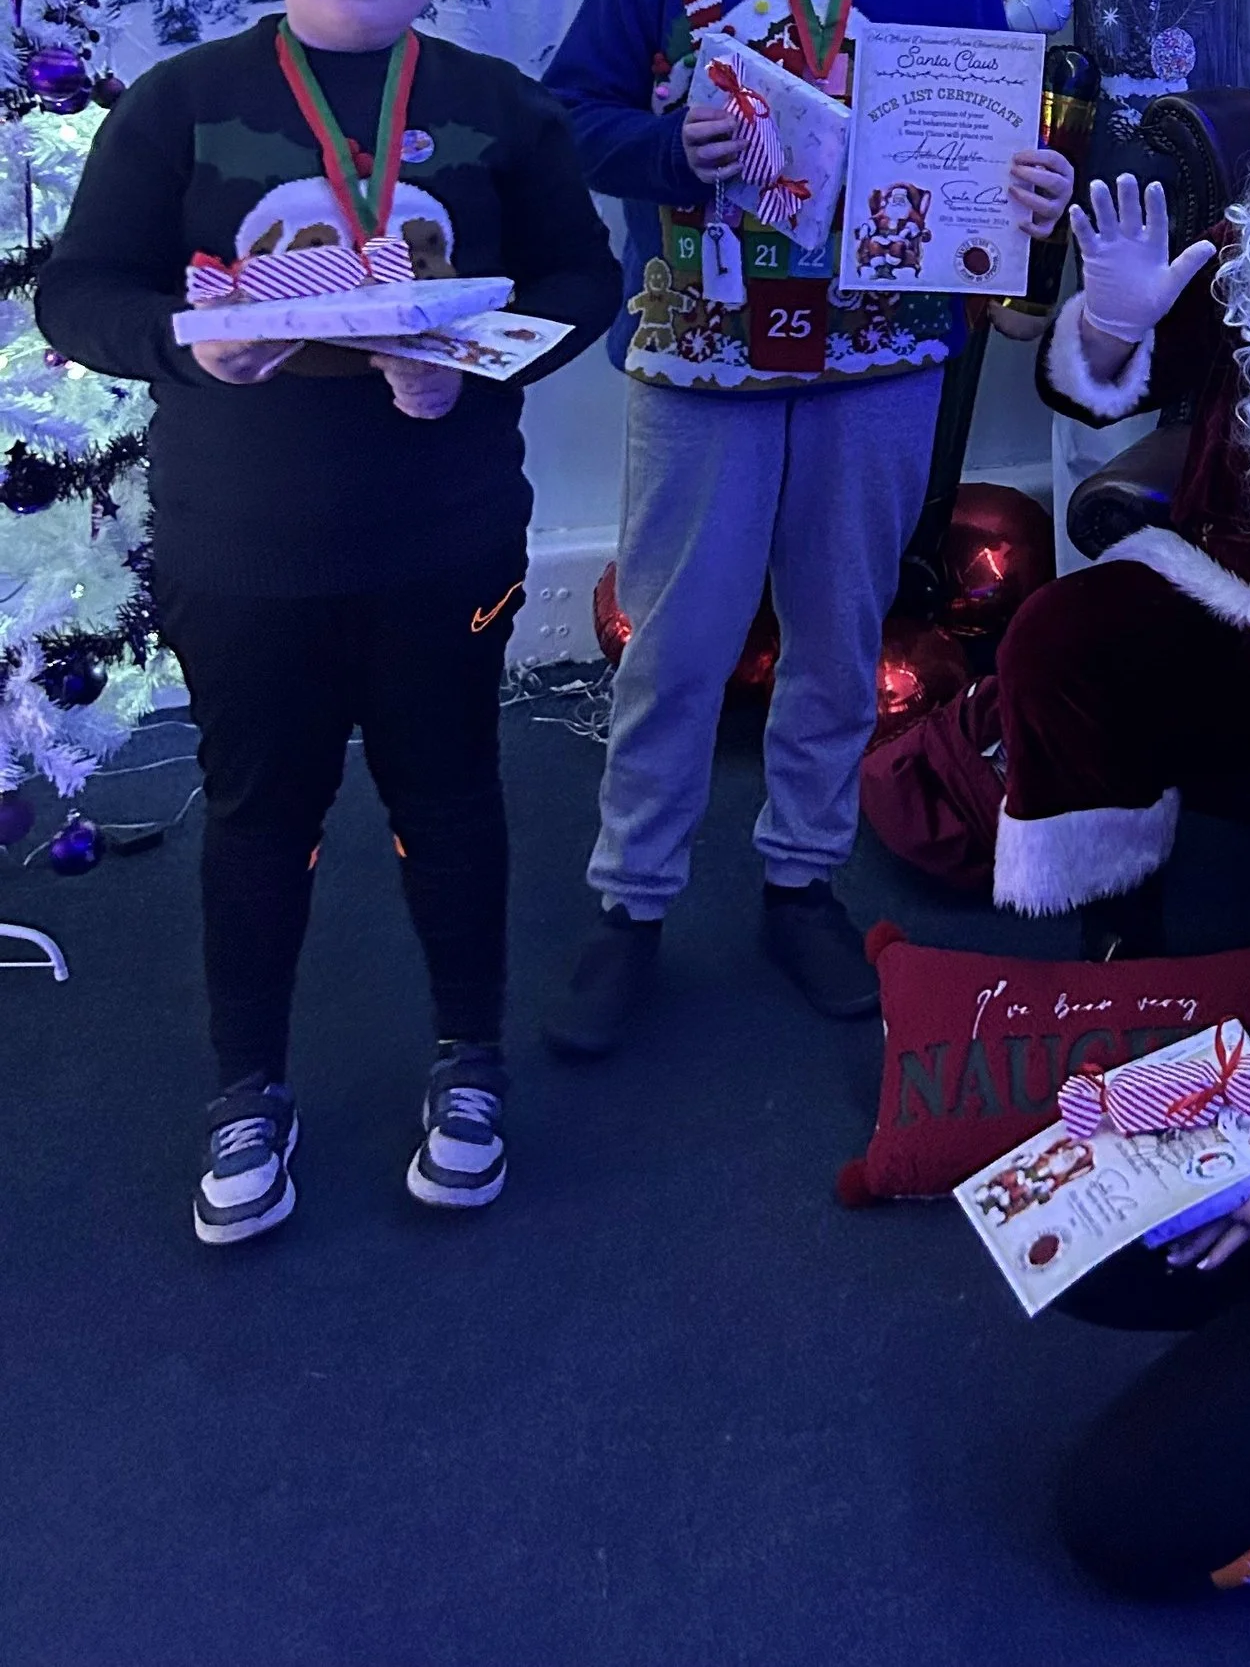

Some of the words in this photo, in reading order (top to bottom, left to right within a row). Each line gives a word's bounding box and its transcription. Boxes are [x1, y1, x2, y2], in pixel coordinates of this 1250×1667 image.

[897, 45, 951, 69] Santa
[954, 50, 999, 72] Claus
[868, 97, 900, 123] NICE
[902, 88, 934, 106] LIST
[937, 87, 1024, 129] CERTIFICATE
[918, 110, 959, 119] recognition
[959, 110, 967, 118] of
[903, 118, 921, 127] good
[972, 123, 989, 131] year
[904, 129, 924, 137] Santa
[678, 236, 695, 259] 19
[754, 244, 779, 267] 21
[797, 246, 825, 268] 22
[767, 308, 813, 339] 25
[1054, 992, 1113, 1020] been
[1137, 996, 1199, 1022] very
